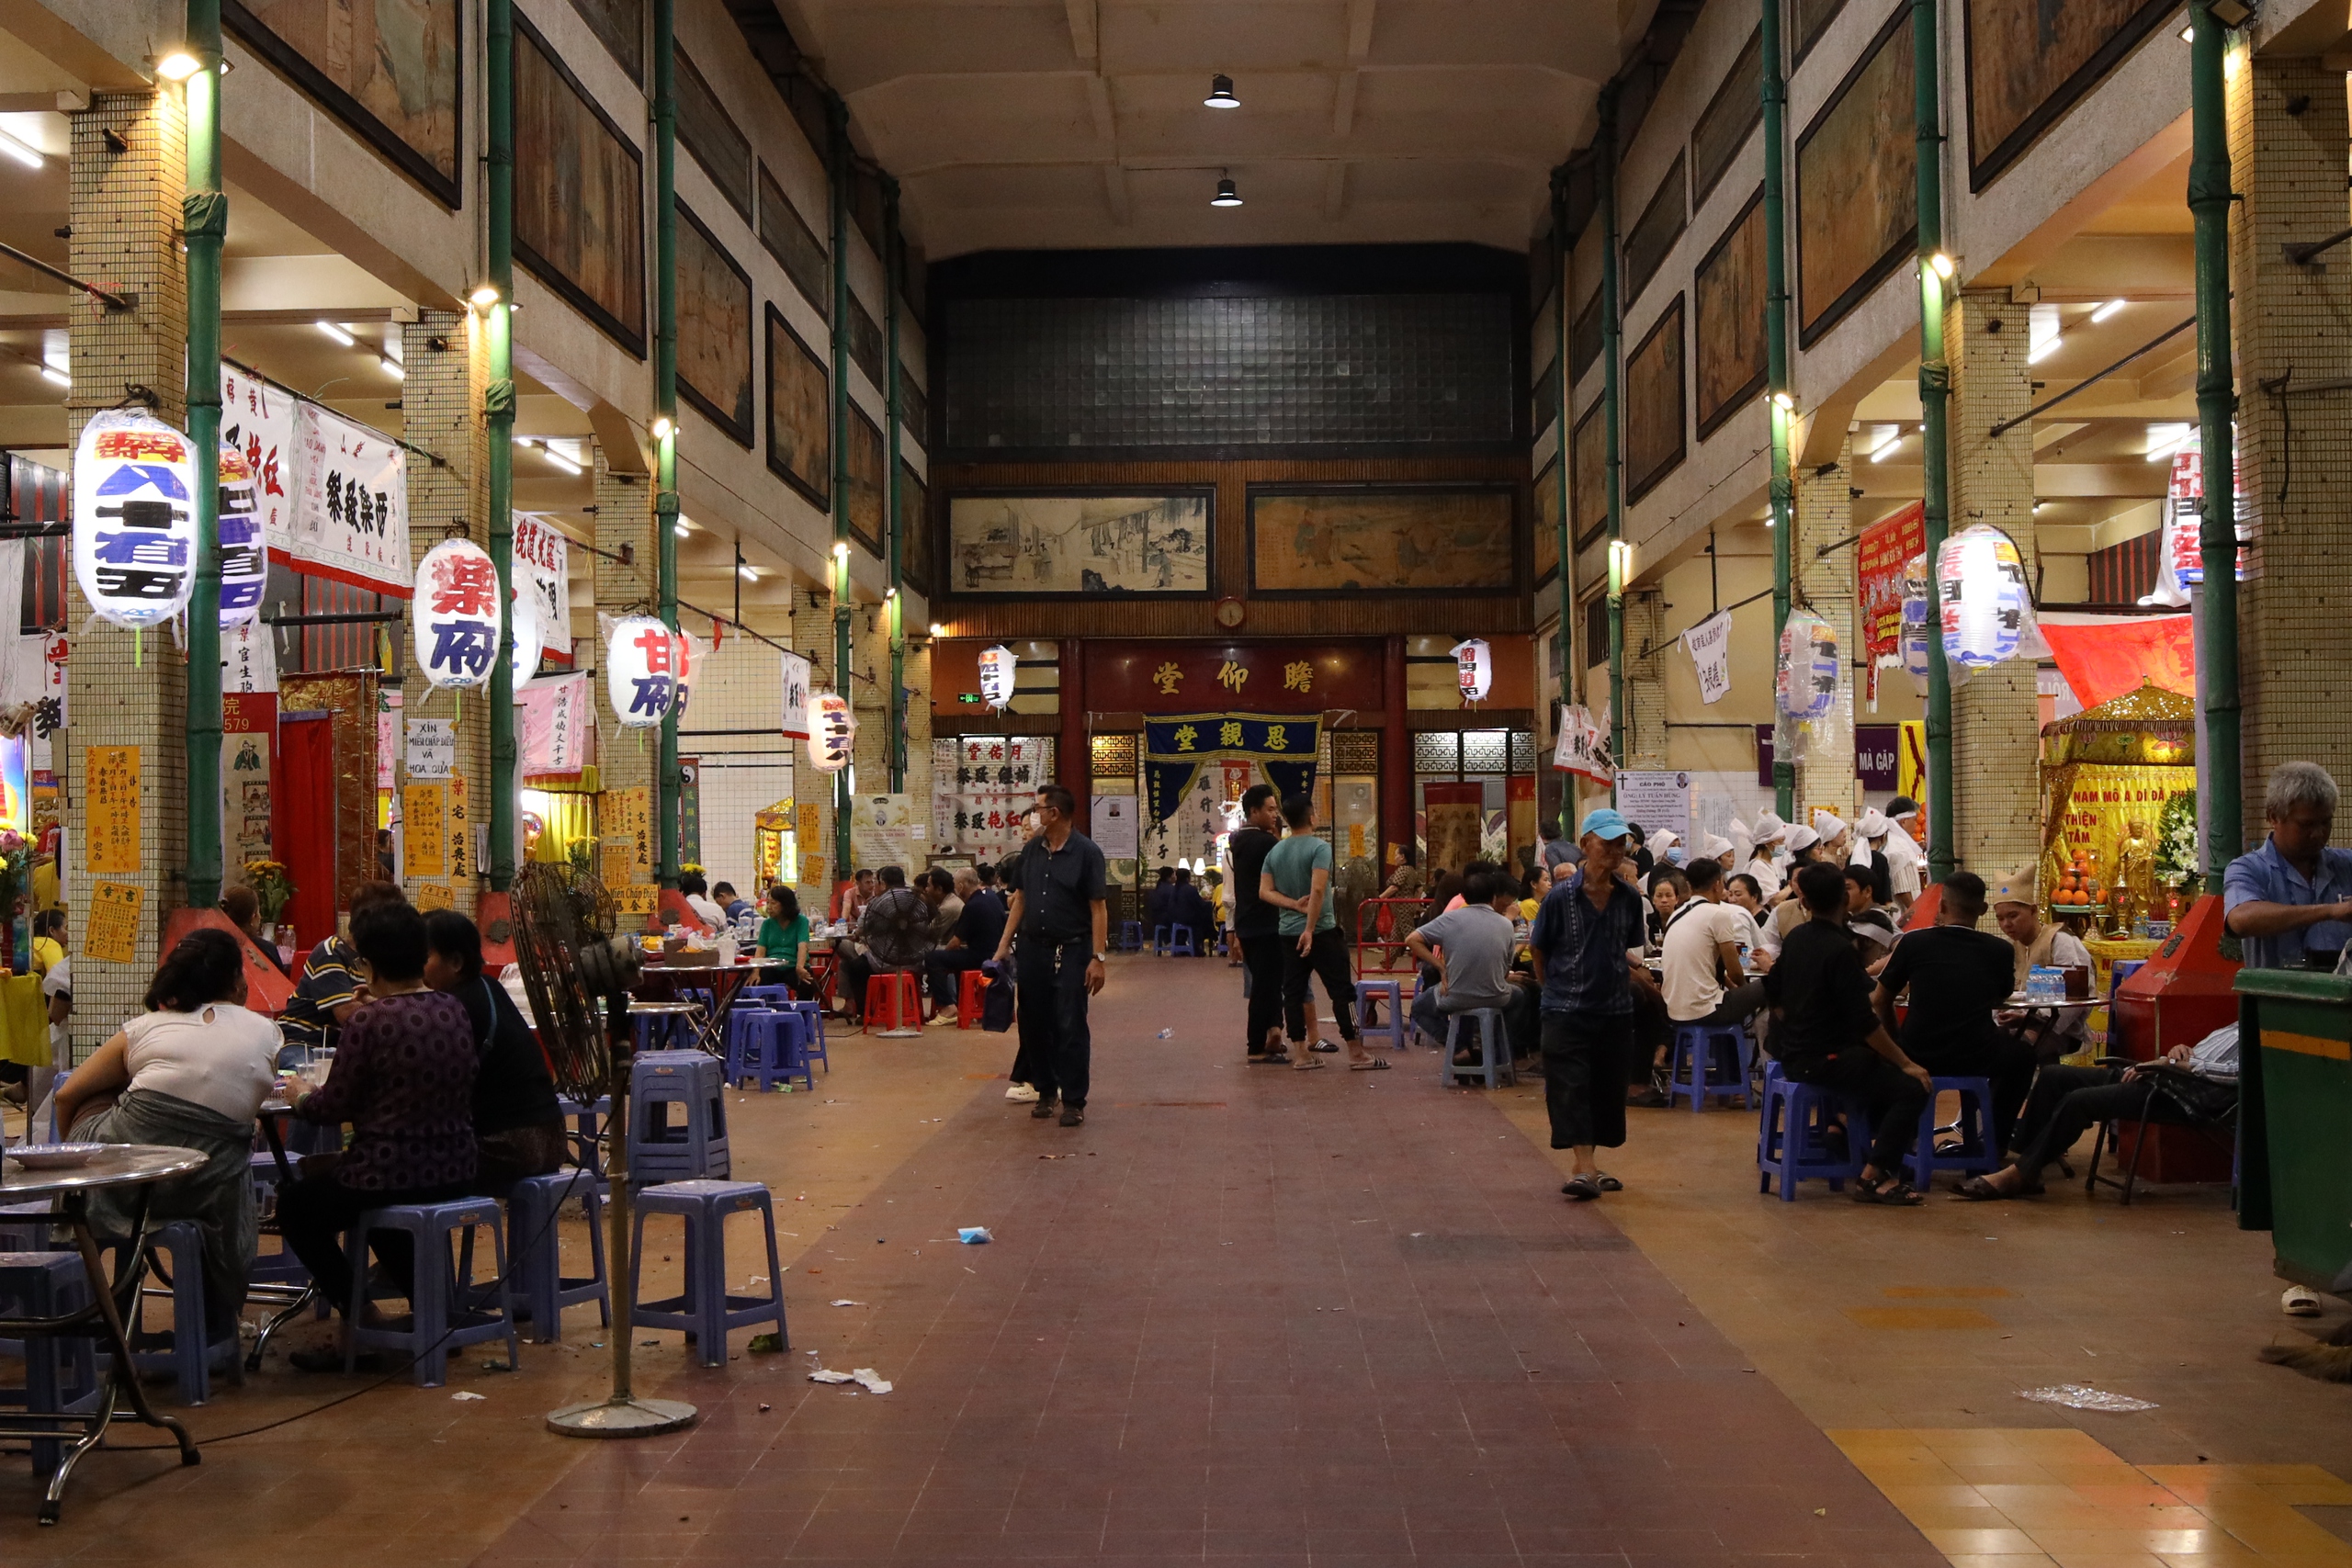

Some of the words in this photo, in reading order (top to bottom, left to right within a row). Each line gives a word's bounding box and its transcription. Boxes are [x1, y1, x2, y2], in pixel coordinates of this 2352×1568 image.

[430, 555, 496, 673] 葉府
[629, 629, 673, 716] 甘府
[409, 764, 426, 773] HOA
[432, 761, 449, 774] QUẢ
[1859, 748, 1874, 771] MÀ
[1876, 749, 1894, 774] GẶP
[2074, 791, 2098, 803] NAM
[2103, 788, 2120, 803] MÔ
[2124, 790, 2131, 802] A
[2065, 811, 2097, 827] THIỆN
[2068, 829, 2090, 843] TÂM
